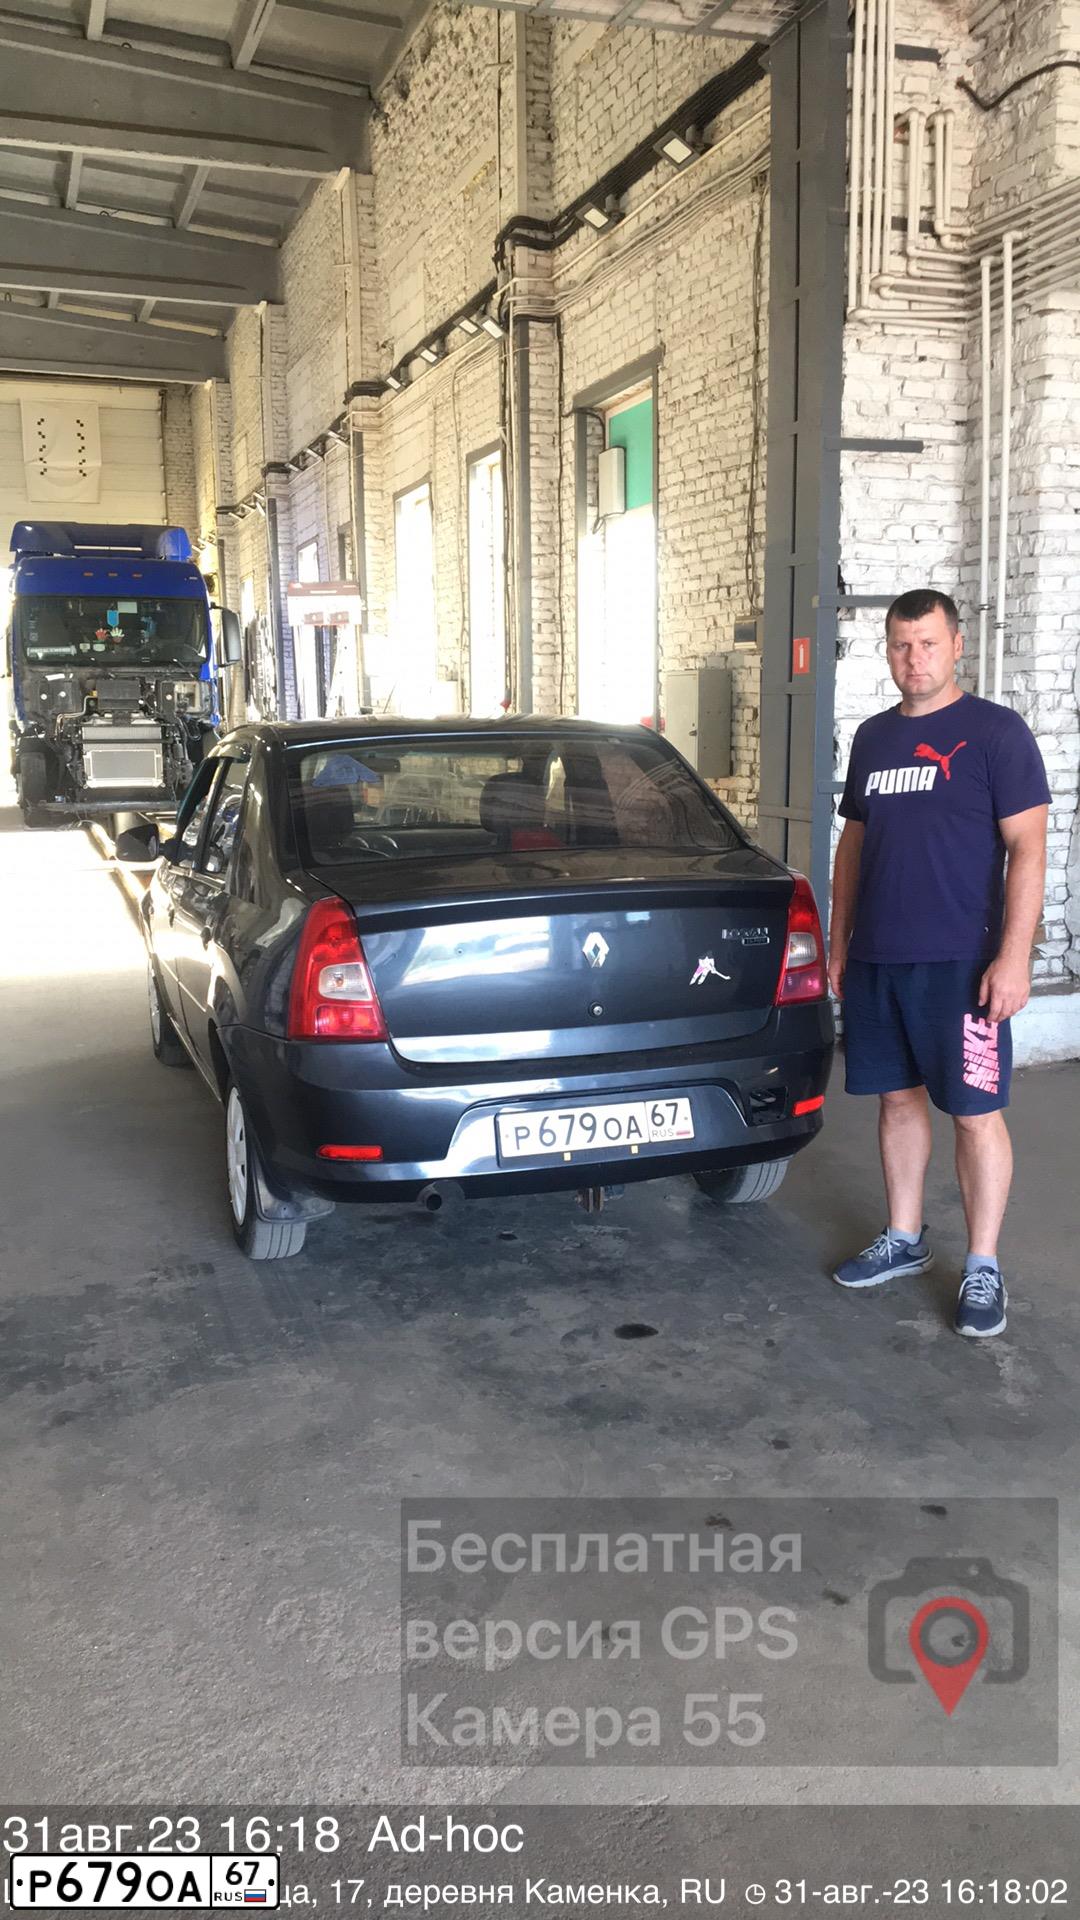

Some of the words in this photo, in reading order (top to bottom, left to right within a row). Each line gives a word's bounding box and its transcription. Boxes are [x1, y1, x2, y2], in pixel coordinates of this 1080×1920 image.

[865, 766, 937, 796] PUMA
[963, 1013, 999, 1094] NIKE
[651, 1102, 679, 1127] 67
[651, 1129, 674, 1138] RUS
